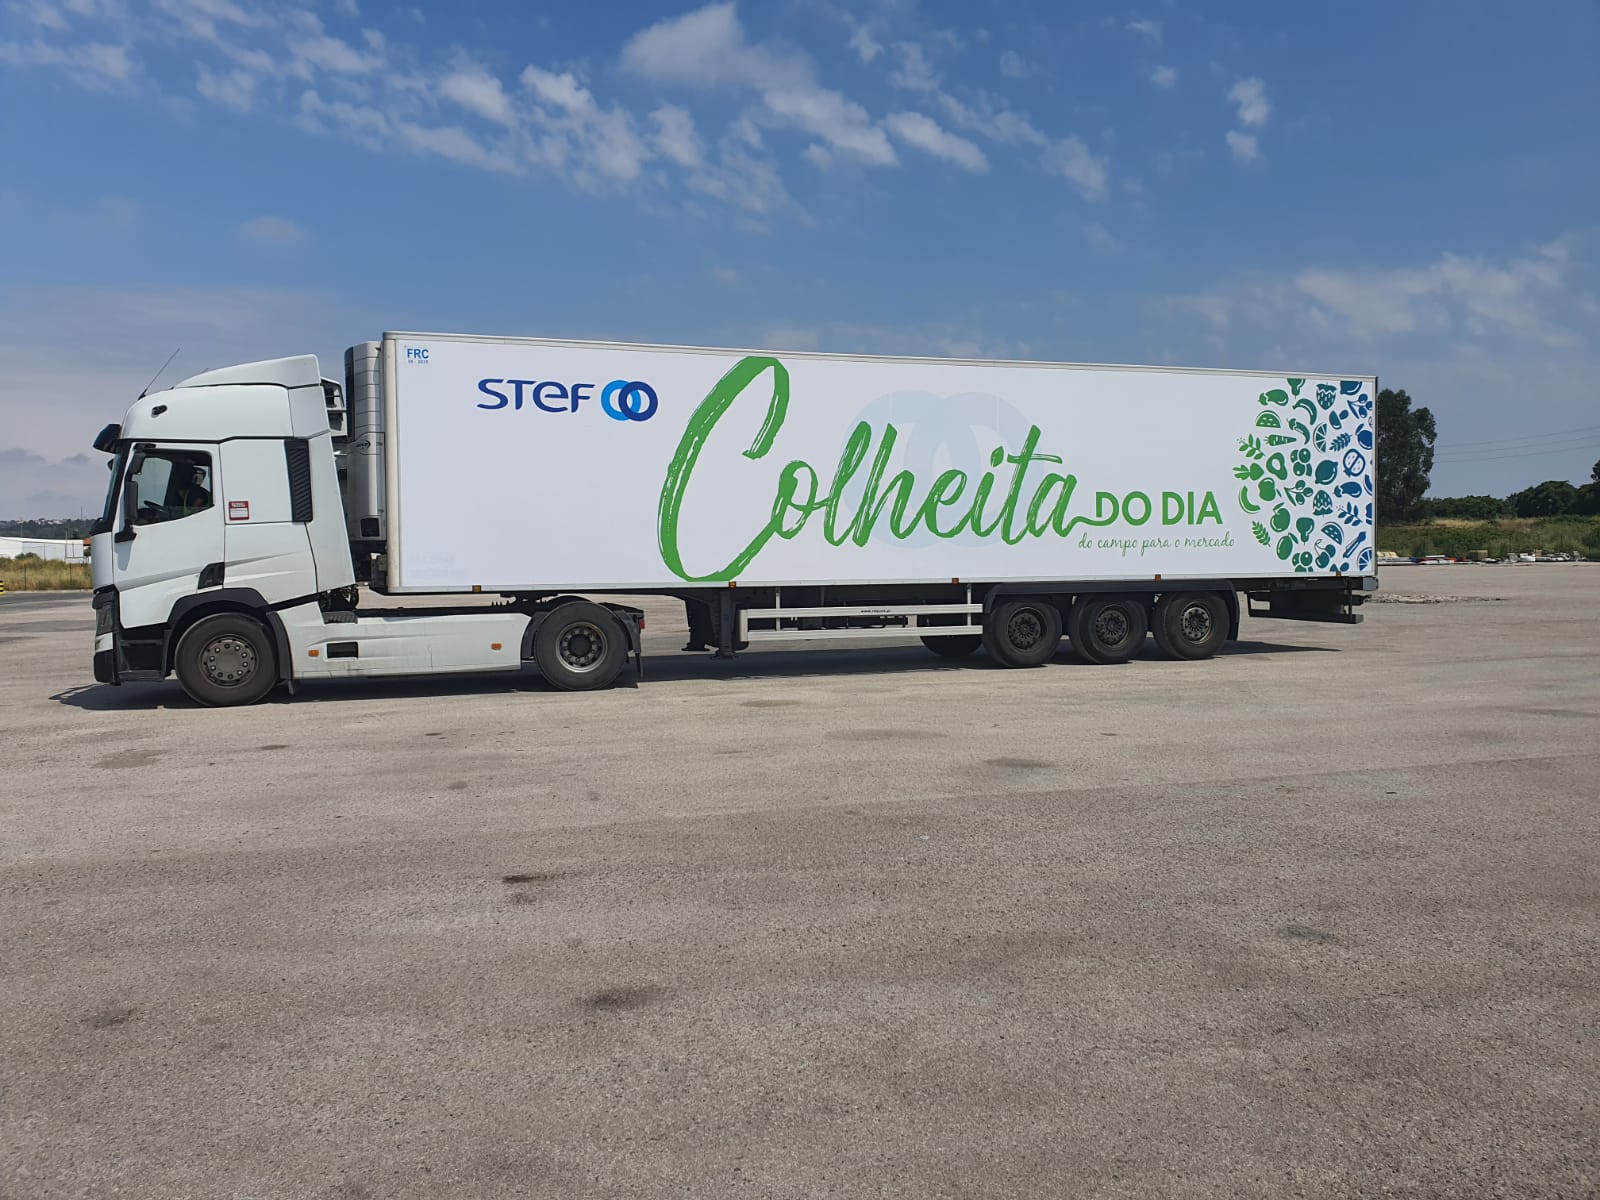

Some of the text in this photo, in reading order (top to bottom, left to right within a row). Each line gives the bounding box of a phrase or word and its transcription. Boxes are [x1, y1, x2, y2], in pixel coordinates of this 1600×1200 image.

[406, 348, 430, 359] FRC
[657, 355, 1224, 582] Colheita DO DIA
[1077, 530, 1235, 557] do campo para o mercado
